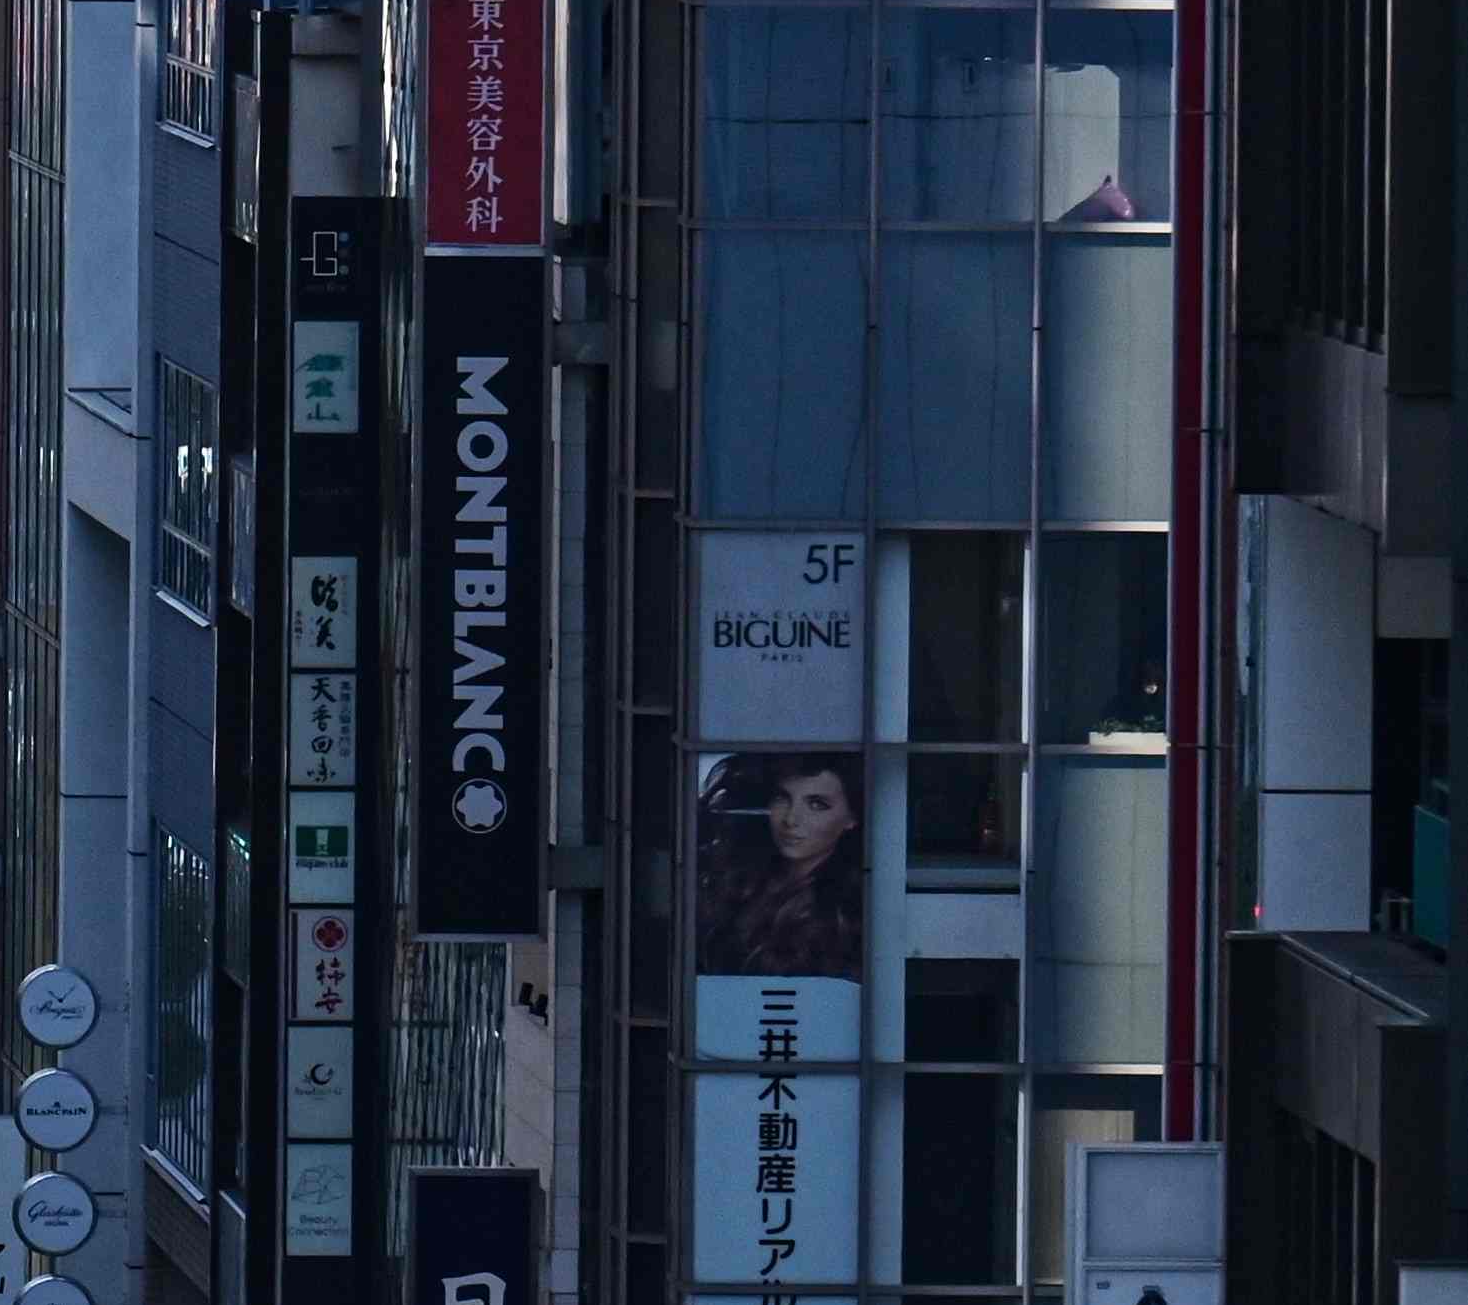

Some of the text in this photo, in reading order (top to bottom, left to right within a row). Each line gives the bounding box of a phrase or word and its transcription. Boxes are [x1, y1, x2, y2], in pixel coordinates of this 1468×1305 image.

[451, 355, 510, 773] MONTBLANC
[801, 543, 856, 586] 5F
[712, 617, 852, 651] BIGUINE
[759, 653, 805, 664] PARIS
[26, 1108, 87, 1117] BLANCPAIN
